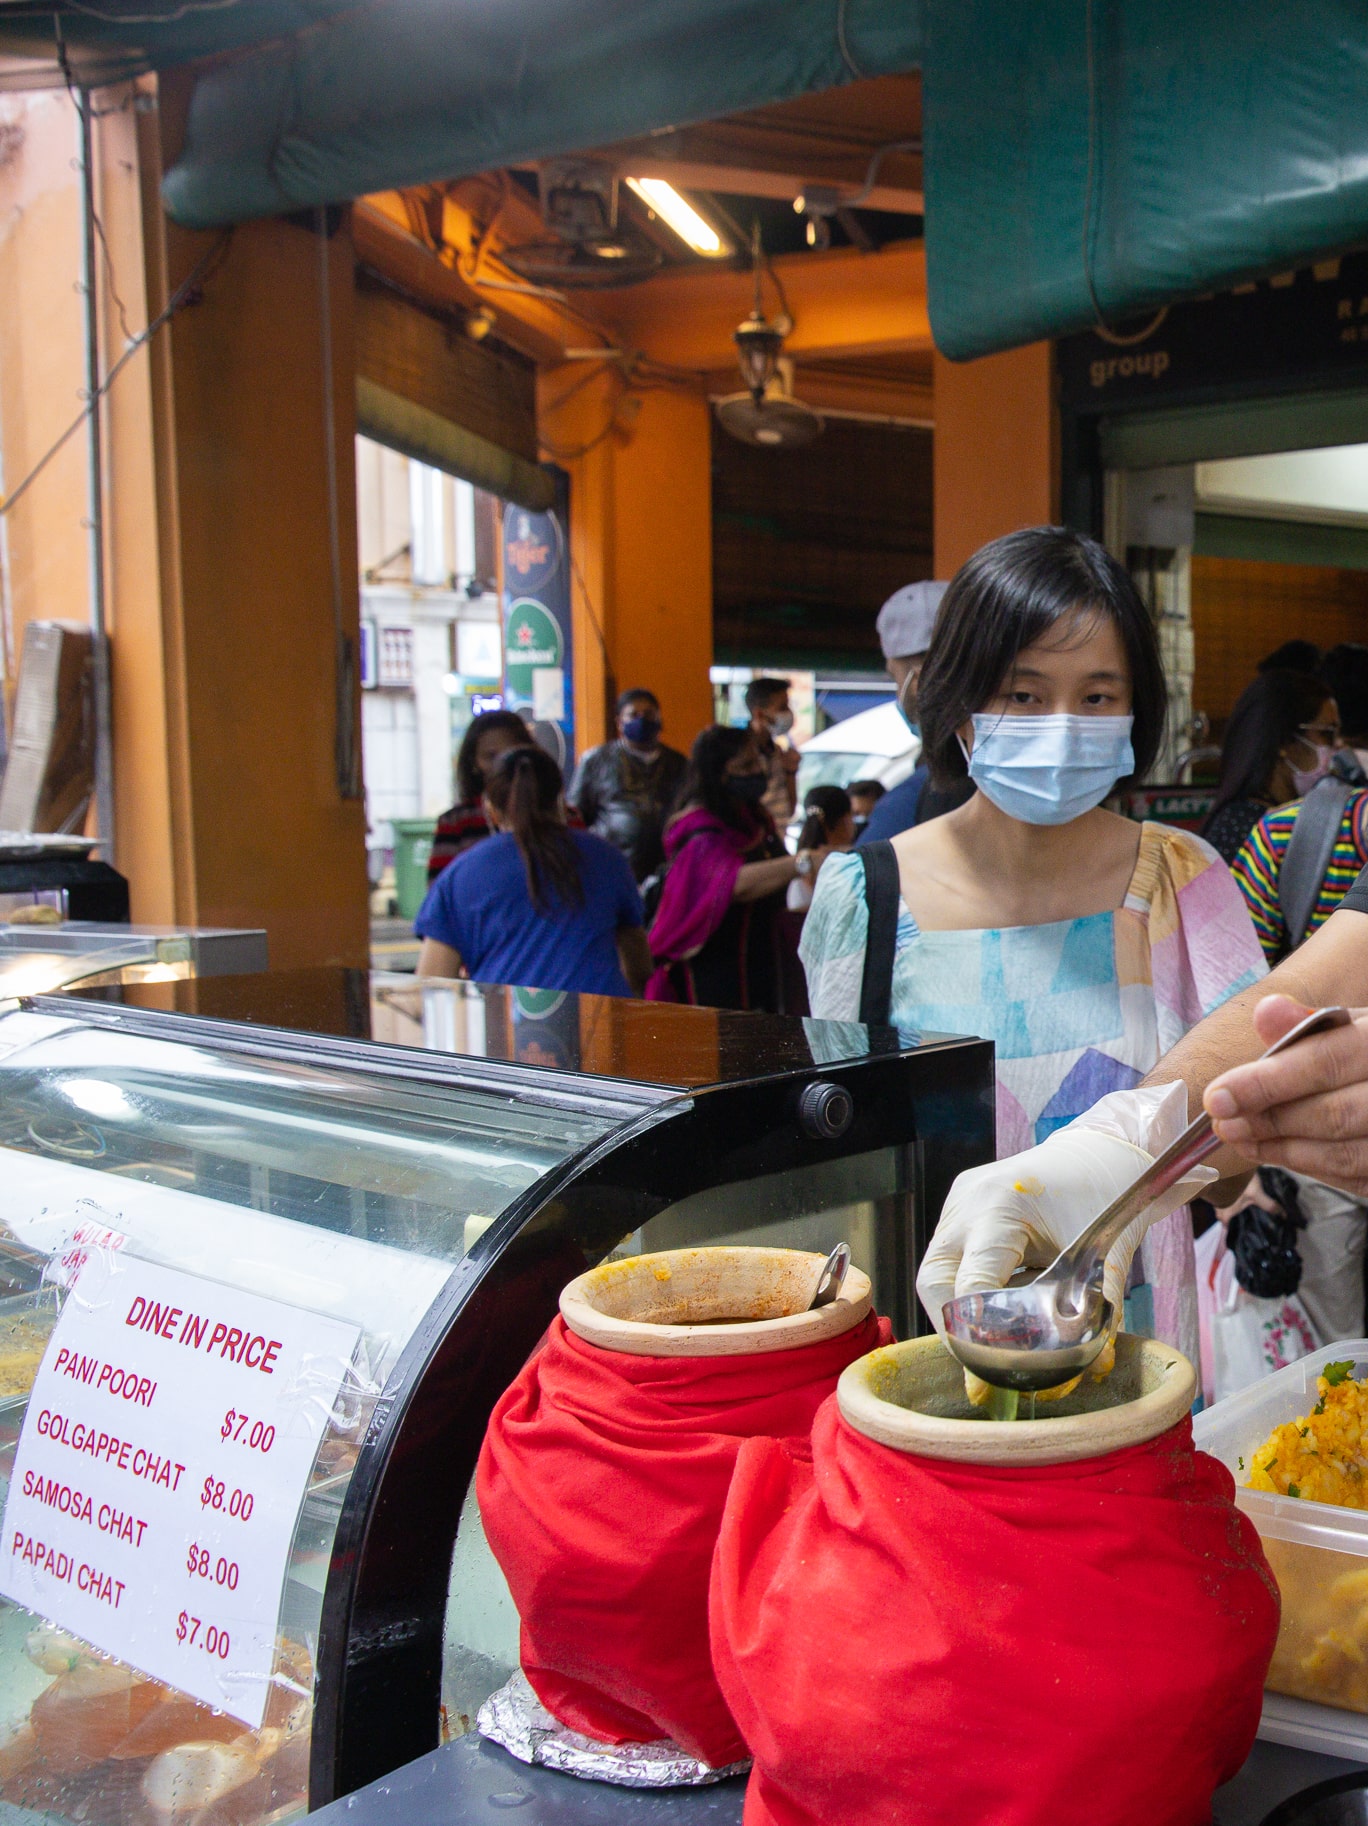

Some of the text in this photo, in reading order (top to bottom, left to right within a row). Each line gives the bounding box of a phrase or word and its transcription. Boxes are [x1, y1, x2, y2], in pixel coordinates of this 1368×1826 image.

[1089, 350, 1170, 388] group
[125, 1296, 283, 1374] DINE IN PRICE
[53, 1348, 158, 1408] PANI POORI
[37, 1409, 254, 1522] GOLGAPPE CHAT $8.00
[221, 1408, 276, 1453] $7.00
[23, 1470, 240, 1591] SAMOSA CHAT $8.00
[12, 1531, 231, 1659] PAPADI CHAT $7.00
